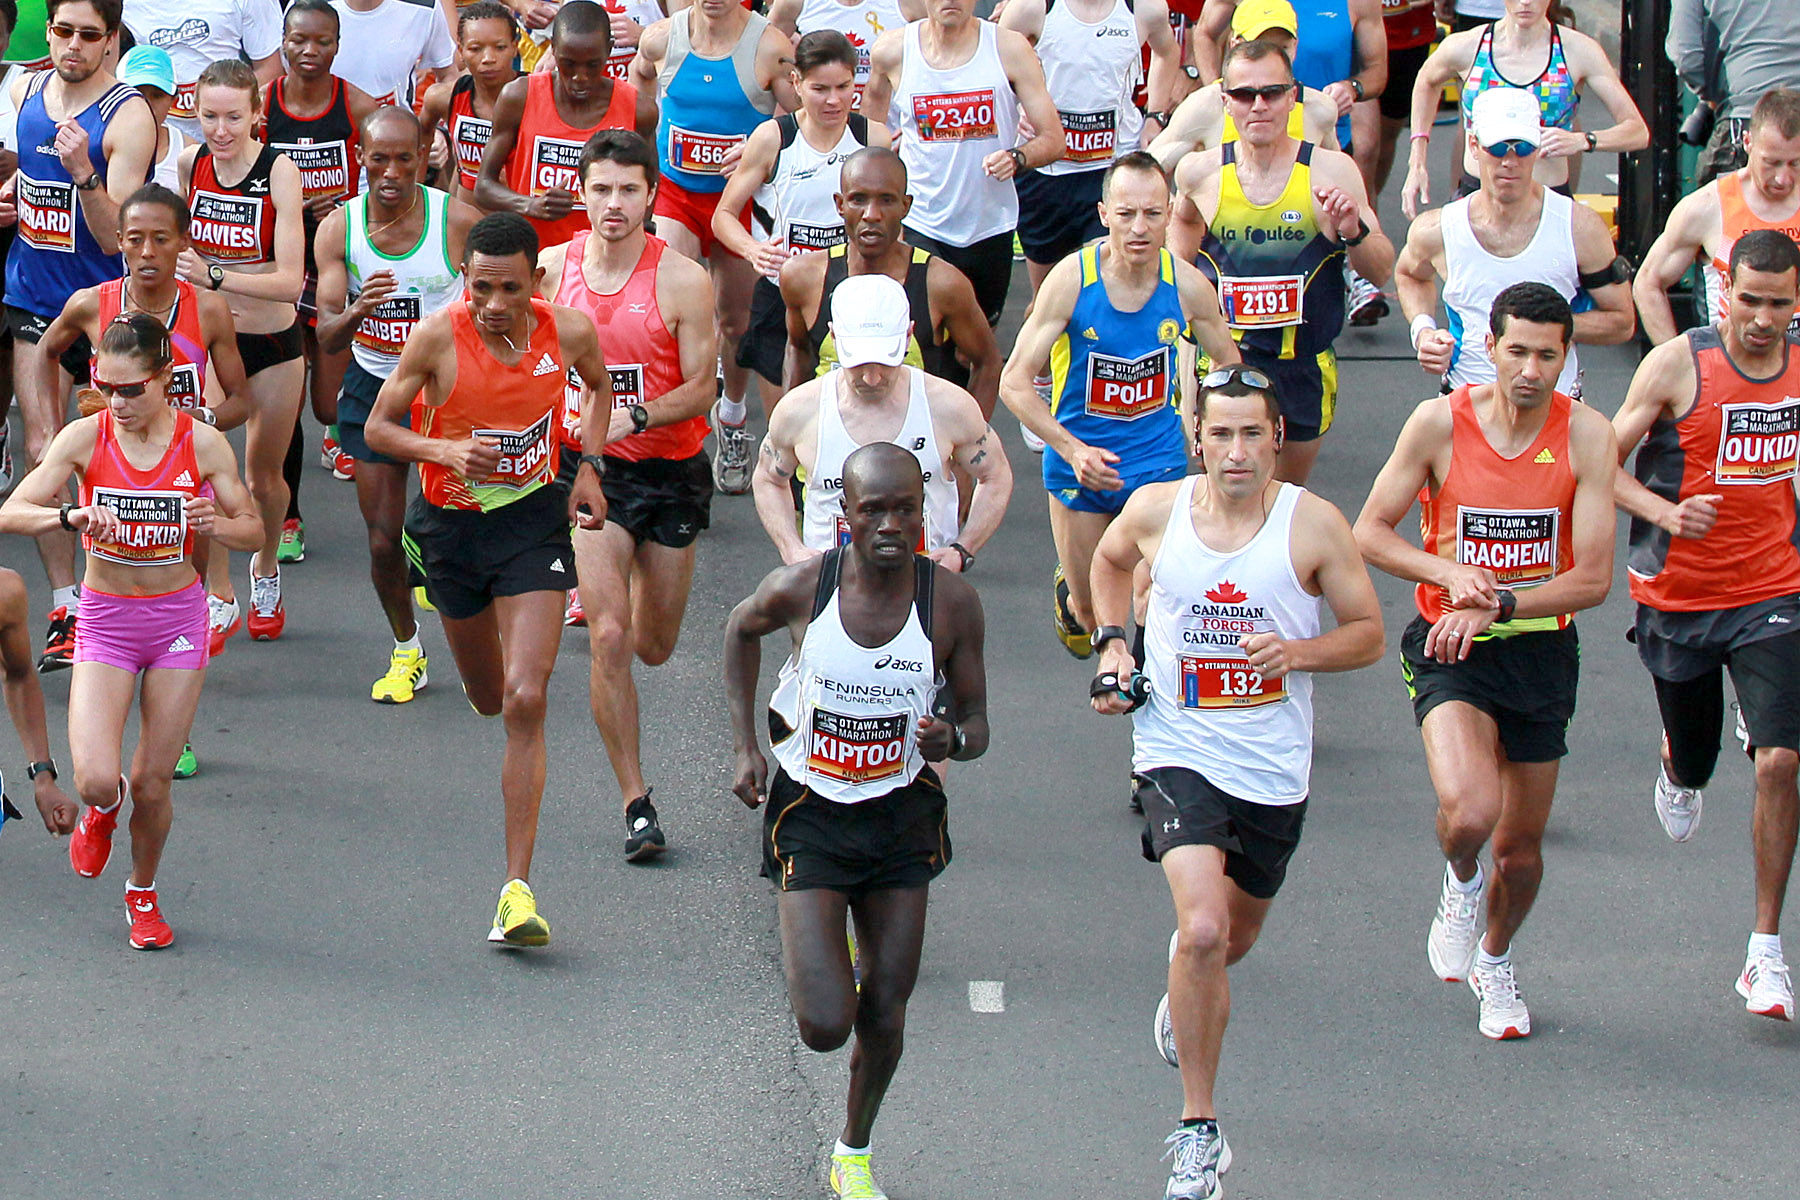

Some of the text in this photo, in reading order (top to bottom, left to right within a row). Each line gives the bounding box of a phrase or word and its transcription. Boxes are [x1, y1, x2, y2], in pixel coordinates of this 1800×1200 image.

[1107, 28, 1129, 37] asics
[931, 104, 991, 129] 2340
[1069, 115, 1096, 123] OTTAWA
[1069, 121, 1105, 130] MARATHON
[292, 151, 320, 160] OTTAWA
[20, 209, 70, 233] RENARD
[191, 219, 254, 248] DAVIES
[809, 228, 836, 238] OTTAWA
[808, 237, 844, 247] MARATHON
[1241, 291, 1289, 314] 2191
[532, 364, 560, 377] adidas
[1116, 362, 1146, 373] OTTAWA
[1115, 369, 1155, 382] MARATHON
[1104, 380, 1153, 405] POLI
[1750, 410, 1781, 422] OTTAWA
[1750, 421, 1790, 433] MARATHON
[1725, 434, 1796, 464] OUKID
[119, 498, 155, 510] OTTAWA
[119, 509, 167, 520] MARATHON
[1488, 517, 1526, 529] OTTAWA
[1488, 528, 1539, 538] MARATHON
[117, 547, 155, 558] MOROCCO
[1464, 540, 1549, 568] RACHEM
[1191, 603, 1263, 618] CANADIAN
[1202, 618, 1254, 632] FORCES
[890, 660, 923, 672] asics
[1204, 662, 1230, 670] OTTAWA
[813, 675, 915, 697] PENINSULA
[1220, 670, 1263, 697] 132
[835, 695, 891, 705] RUNNERS
[839, 718, 878, 730] OTTAWA
[839, 728, 891, 741] MARATHON
[812, 733, 901, 769] KIPTOO
[841, 769, 869, 779] KENYA
